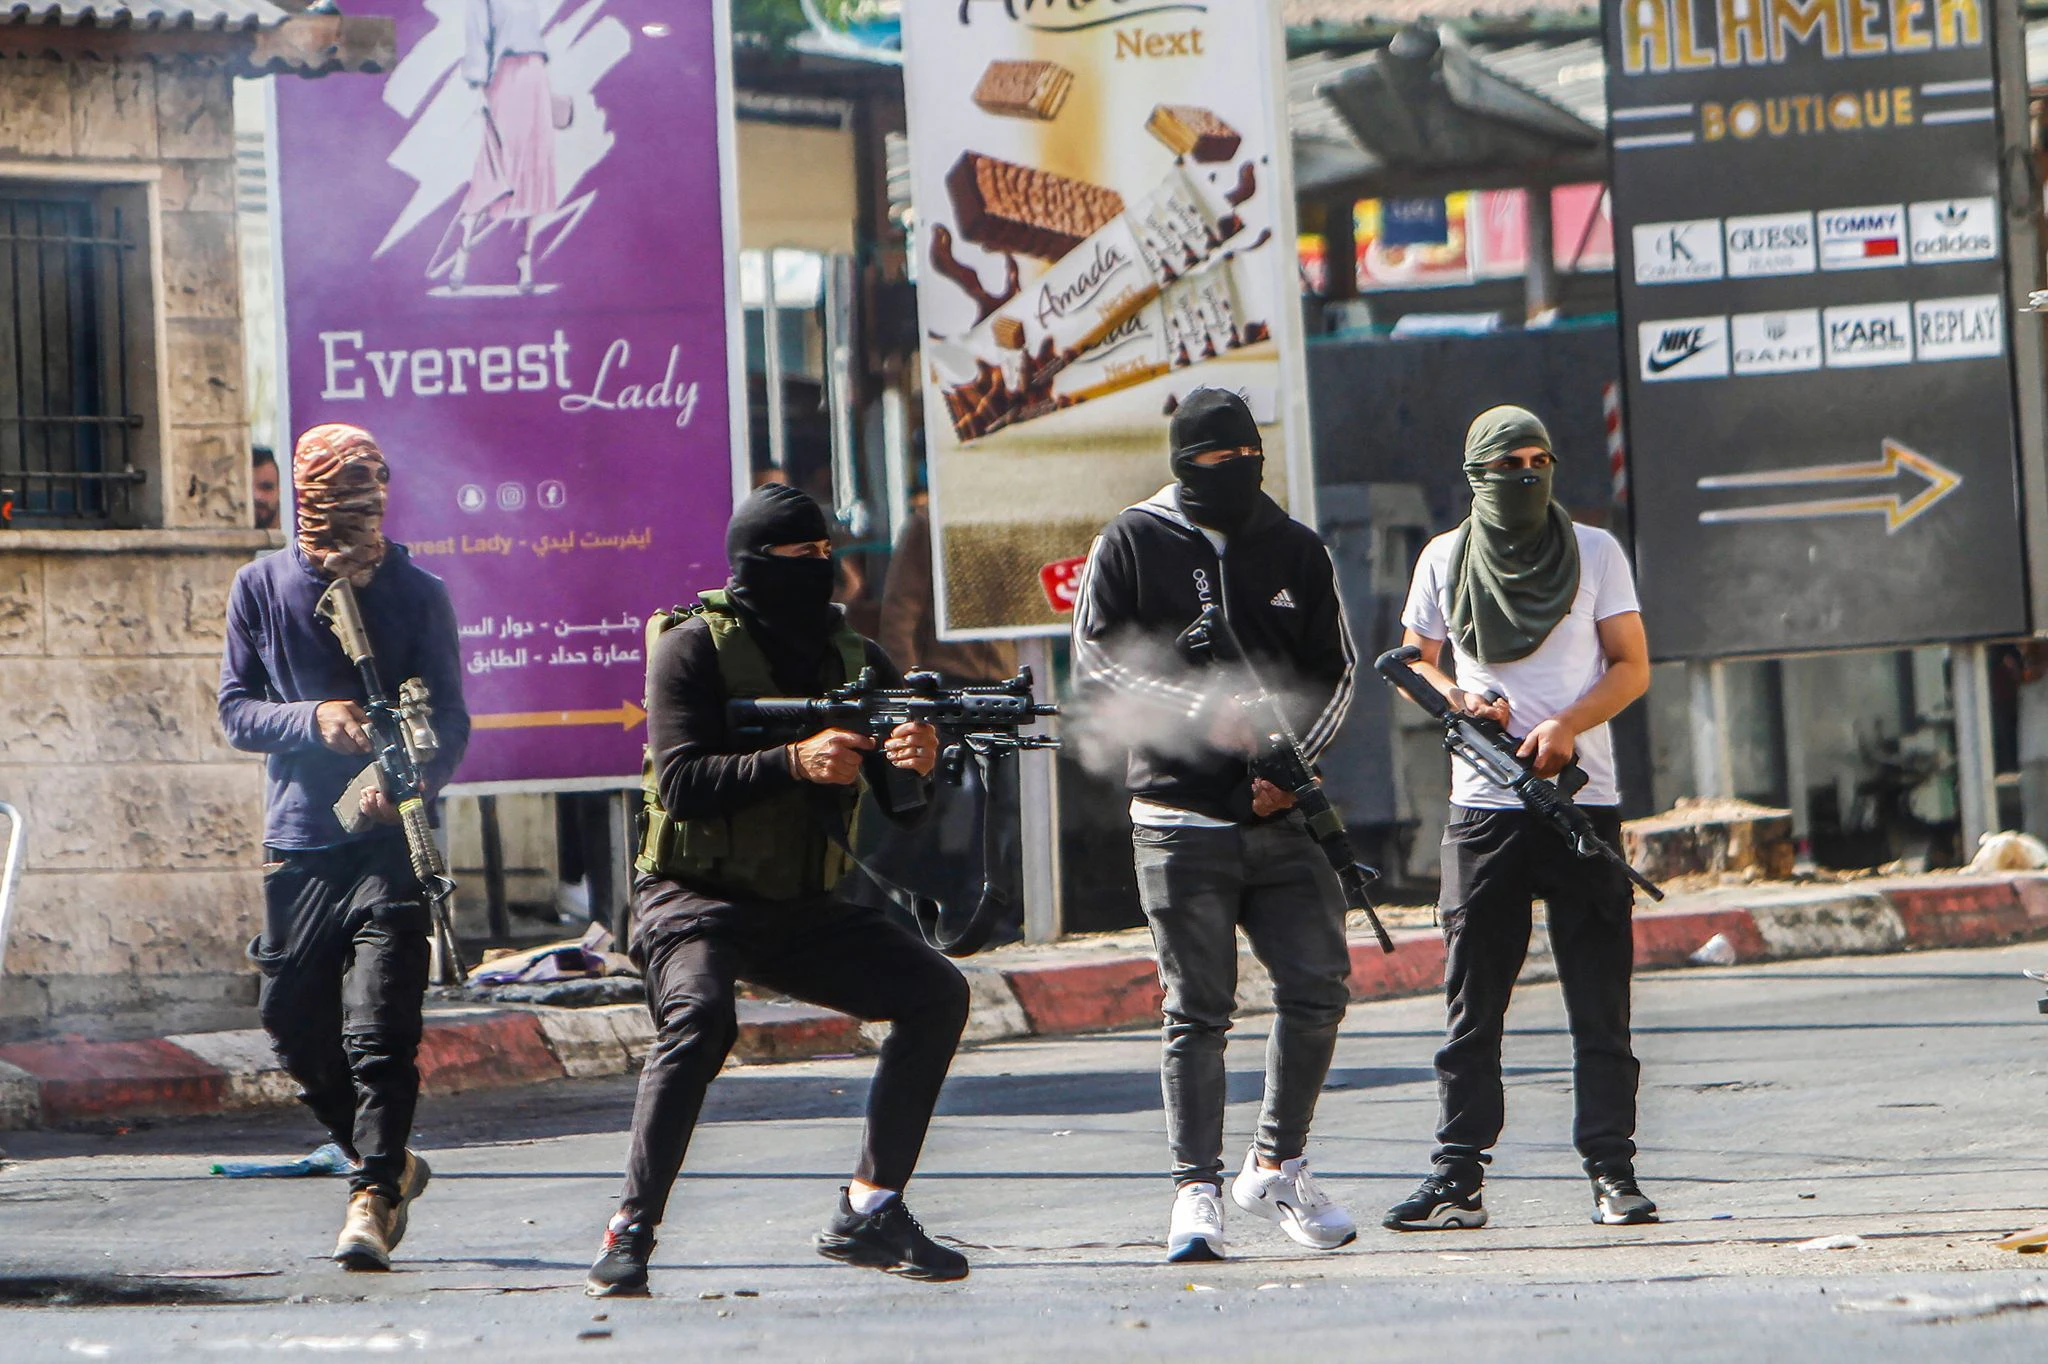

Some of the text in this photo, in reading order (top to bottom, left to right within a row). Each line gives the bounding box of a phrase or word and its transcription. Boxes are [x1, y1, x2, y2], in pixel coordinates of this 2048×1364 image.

[1115, 28, 1205, 60] Next
[1702, 86, 1914, 142] BOUTIQUE
[1825, 211, 1897, 234] TOMMY
[1730, 224, 1809, 252] GUESS
[1914, 233, 1992, 255] adidas
[1035, 241, 1127, 329] Amada
[1658, 325, 1706, 352] NIKE
[1831, 316, 1905, 345] KARL
[1919, 304, 1998, 346] REPLAY
[318, 329, 699, 428] Everest Lady
[460, 533, 513, 556] Lady
[531, 530, 576, 557] ليدي
[499, 614, 535, 640] دوار
[466, 648, 528, 675] الطابق
[548, 645, 588, 665] حداد
[592, 643, 642, 667] عمارة
